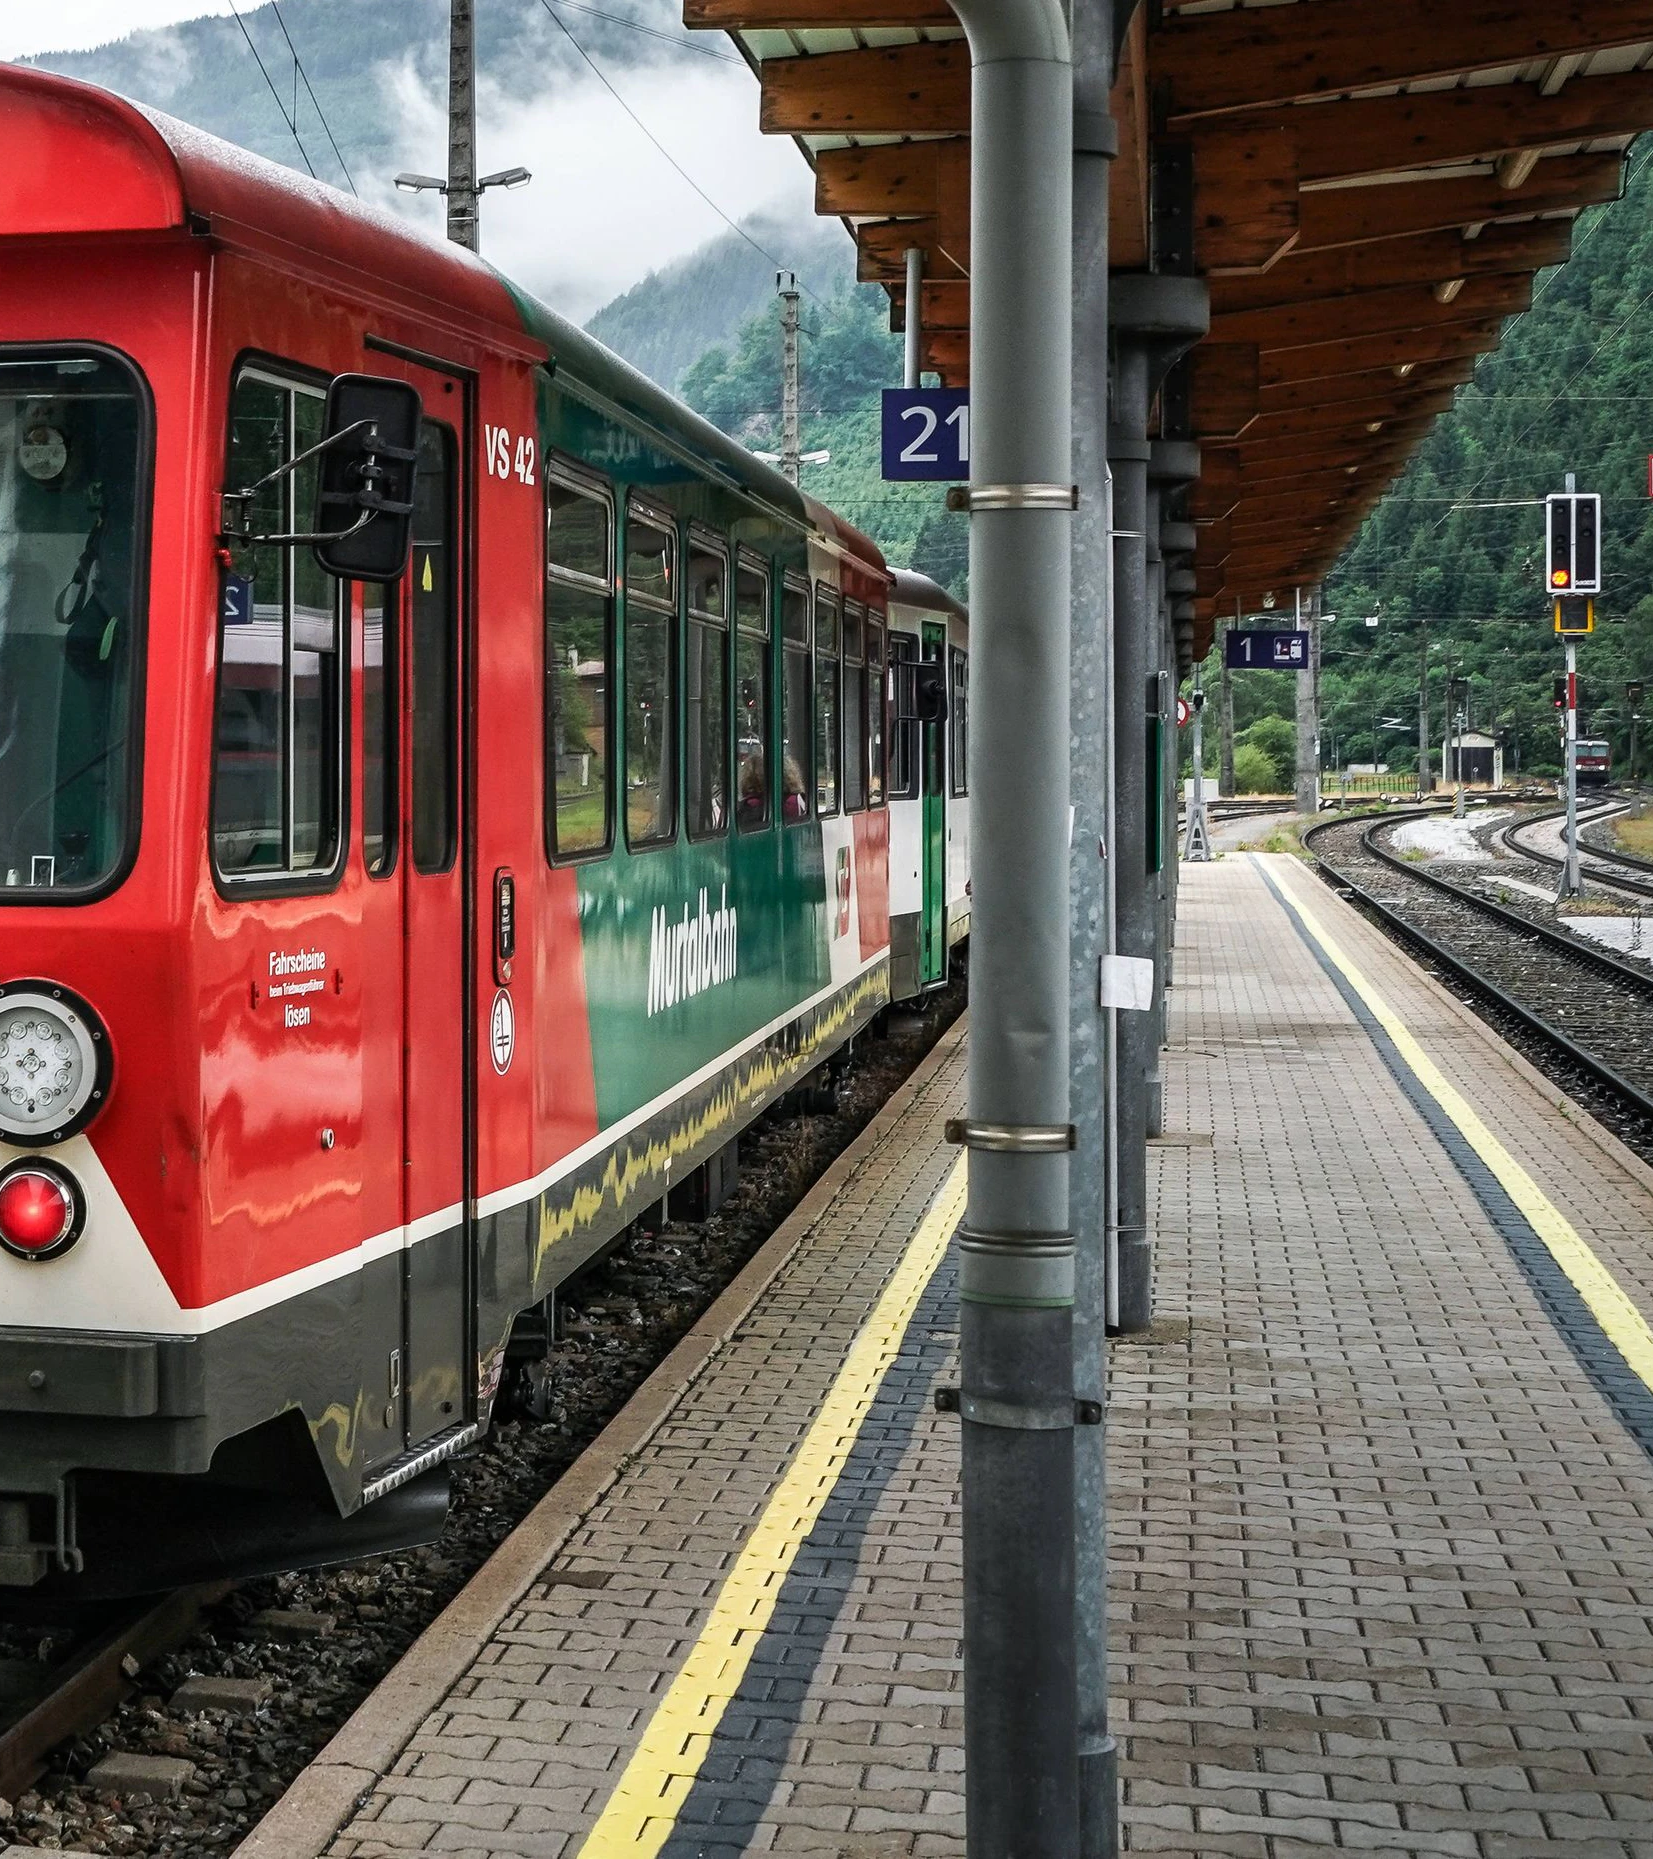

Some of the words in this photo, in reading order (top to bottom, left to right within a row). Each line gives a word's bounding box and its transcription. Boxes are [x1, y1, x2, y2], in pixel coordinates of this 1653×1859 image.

[485, 424, 510, 480] VS
[514, 436, 535, 486] 42
[900, 405, 969, 462] 21
[1240, 637, 1252, 662] 1
[269, 947, 326, 976] Fahrscheine
[647, 883, 737, 1018] Murtalbahn
[285, 1004, 310, 1028] lösen
